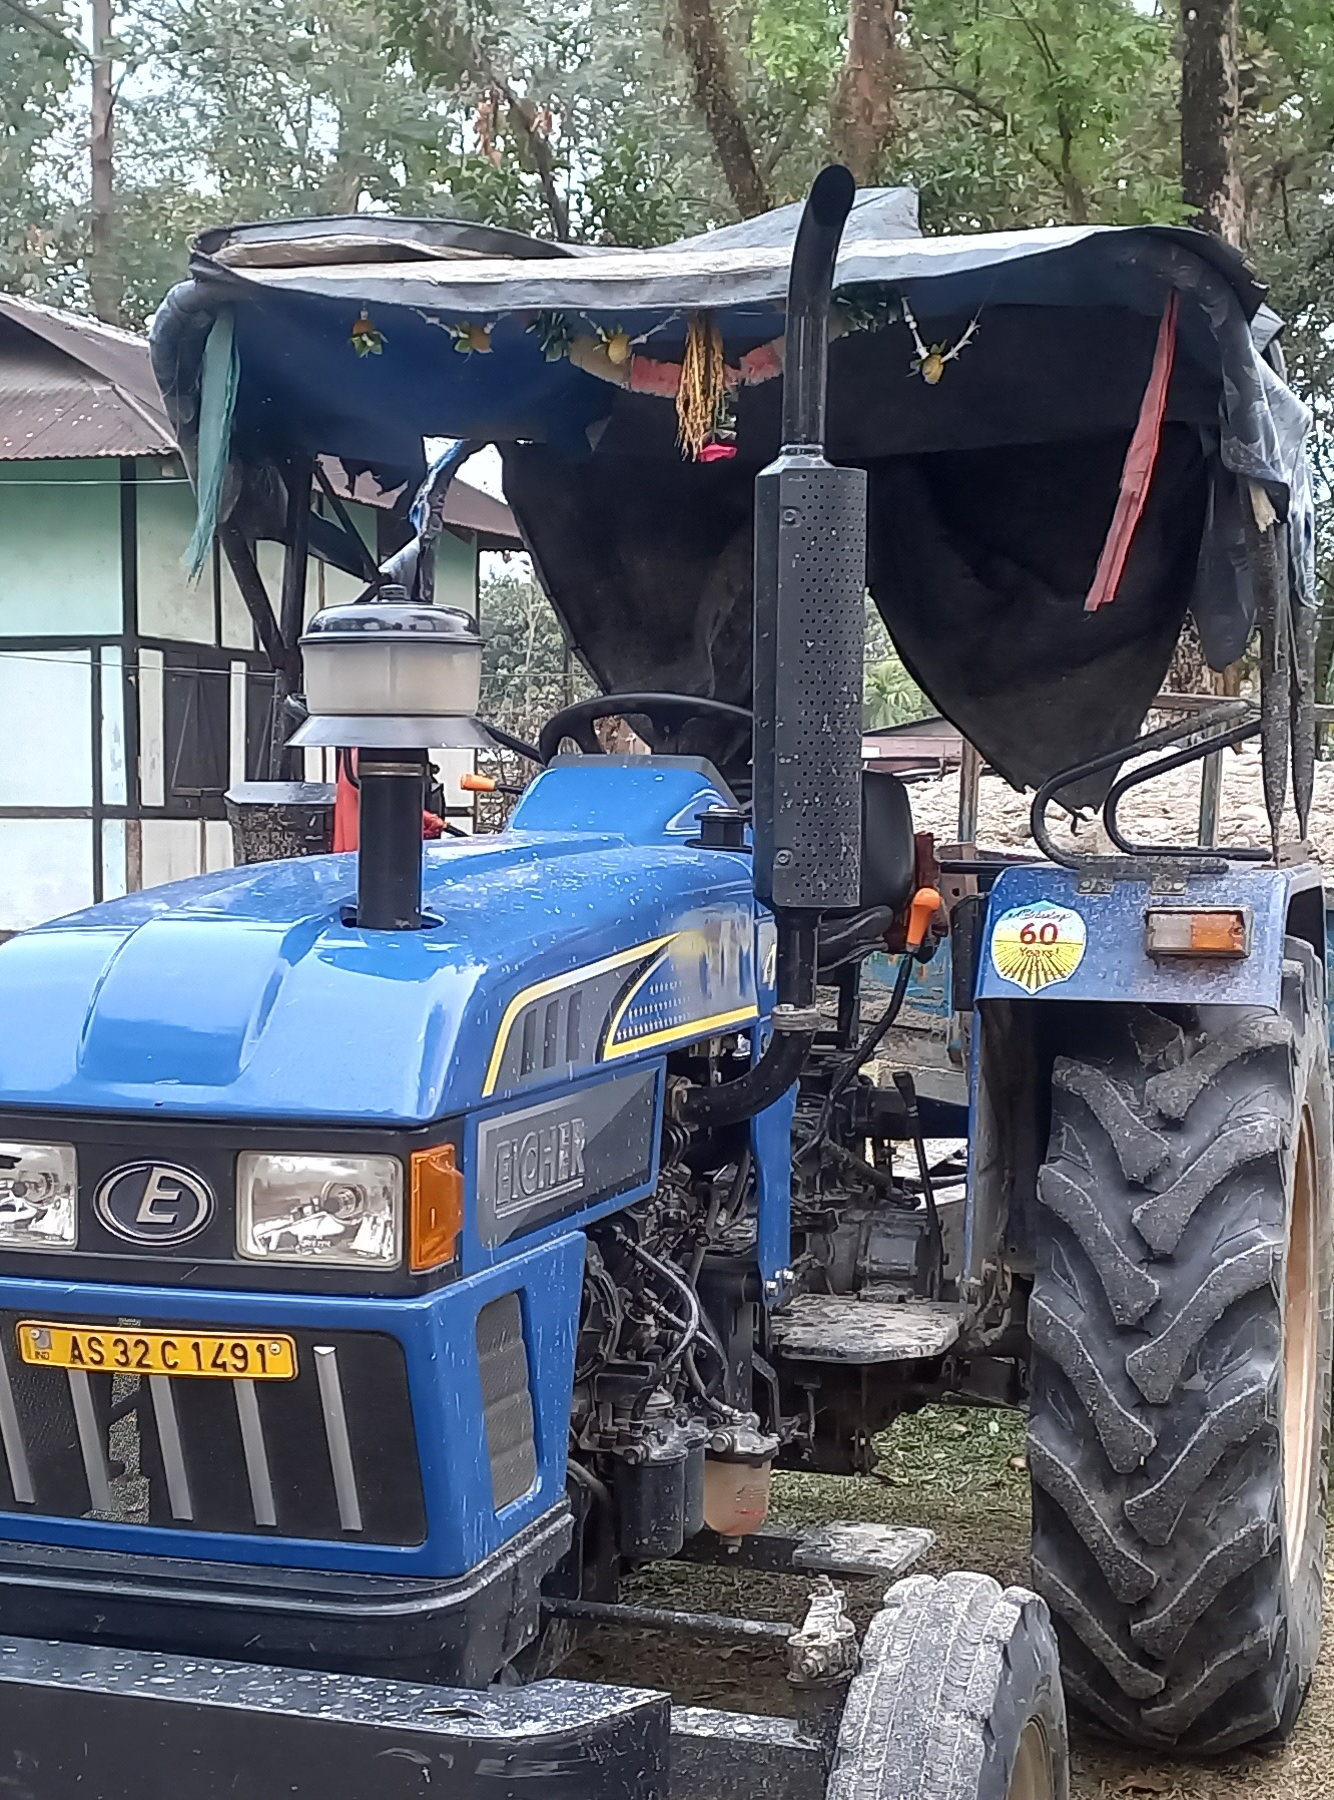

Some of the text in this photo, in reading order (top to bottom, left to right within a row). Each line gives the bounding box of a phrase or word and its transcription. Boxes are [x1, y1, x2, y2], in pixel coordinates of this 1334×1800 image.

[1020, 922, 1058, 945] 60
[493, 1117, 585, 1206] EICHER
[71, 1335, 268, 1374] AS 32 C 1491
